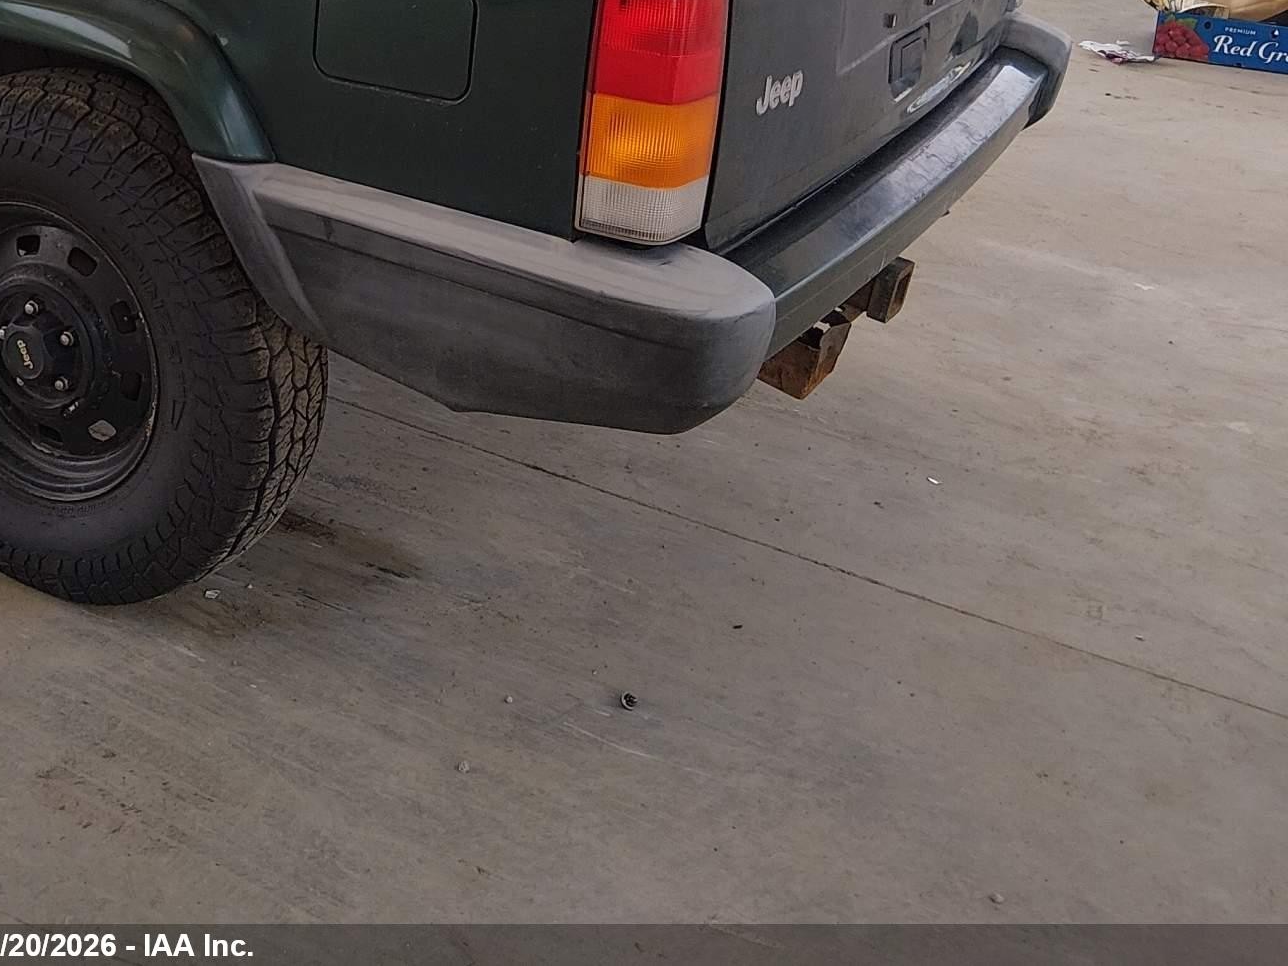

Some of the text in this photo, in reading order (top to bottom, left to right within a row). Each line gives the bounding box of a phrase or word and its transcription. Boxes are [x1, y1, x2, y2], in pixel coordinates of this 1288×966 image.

[1224, 26, 1257, 36] PREMIUM
[1213, 34, 1288, 64] Red Gr
[756, 70, 804, 116] Jeep
[16, 339, 34, 370] Jeep
